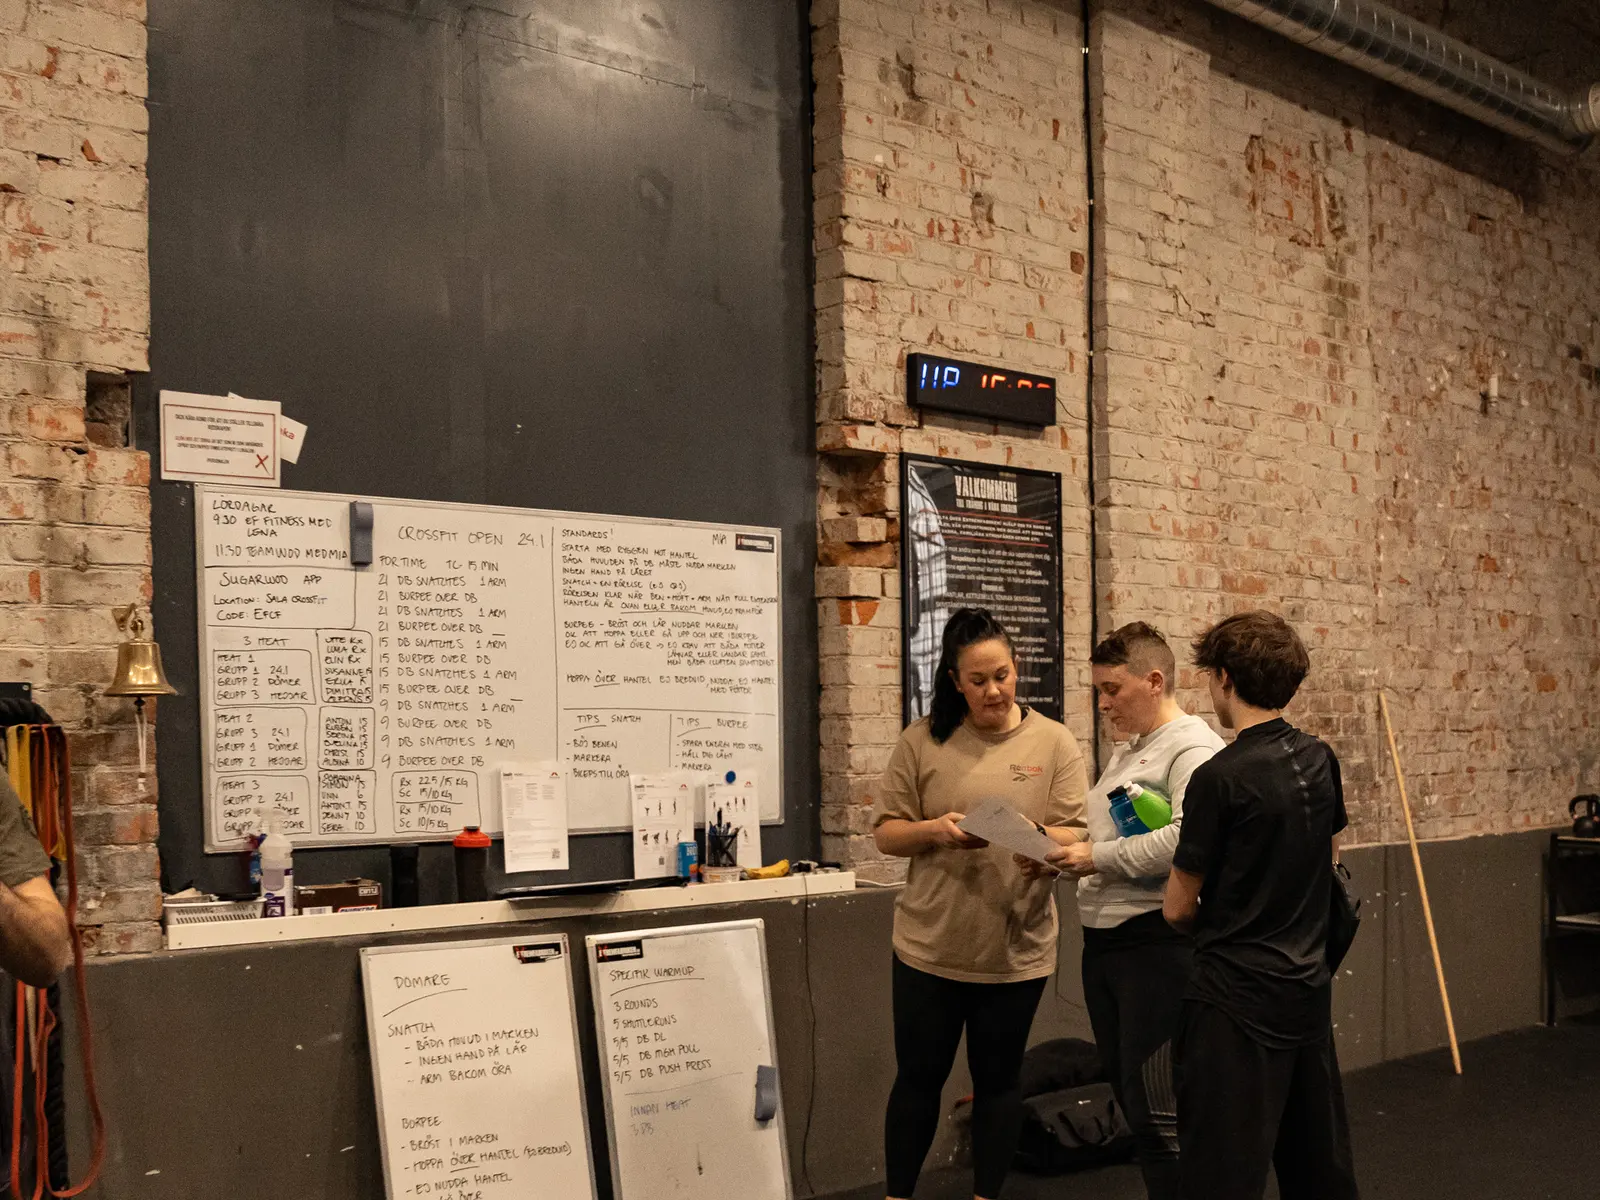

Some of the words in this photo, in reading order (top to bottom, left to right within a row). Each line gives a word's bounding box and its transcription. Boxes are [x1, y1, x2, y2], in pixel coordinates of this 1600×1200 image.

[263, 516, 305, 527] FITNESS
[309, 517, 333, 528] MED
[398, 526, 459, 542] CROSSFIT
[468, 532, 503, 545] OPEN
[517, 533, 545, 548] 24.1
[561, 543, 590, 552] STARTA
[480, 561, 499, 571] MIN
[219, 572, 288, 587] SUGARWOD
[303, 574, 322, 585] APP
[378, 574, 389, 586] 21
[397, 576, 413, 586] DB
[487, 577, 507, 587] ARM
[266, 593, 288, 604] SALA
[377, 591, 389, 602] 21
[398, 591, 432, 602] BURPEE
[435, 592, 459, 602] OVER
[465, 593, 478, 603] DB
[254, 608, 282, 620] EFCF
[377, 605, 389, 616] 21
[396, 605, 411, 616] DB
[488, 608, 507, 619] ARM
[378, 621, 389, 632] 21
[398, 621, 439, 632] BURPEE
[441, 621, 466, 633] OVER
[469, 623, 484, 634] DB
[244, 636, 251, 646] 3
[378, 637, 389, 647] 15
[397, 638, 411, 647] DB
[486, 640, 507, 650] ARM
[379, 653, 390, 664] 15
[398, 653, 436, 664] BURPEE
[441, 654, 468, 664] OVER
[476, 655, 491, 665] DB
[379, 667, 389, 677] 15
[397, 667, 415, 677] DB
[418, 667, 477, 679] SNATCHES
[495, 670, 517, 680] ARM
[217, 677, 248, 687] GRUPP
[379, 684, 390, 694] 15
[397, 684, 440, 694] BURPEE
[444, 684, 470, 695] OVER
[478, 685, 494, 696] DB
[379, 699, 389, 712] 9
[397, 700, 412, 711] DB
[492, 703, 515, 713] ARM
[380, 715, 389, 729] 9
[397, 718, 438, 729] BURPEE
[443, 719, 468, 729] OVER
[476, 719, 492, 730] DB
[381, 734, 390, 748] 9
[398, 737, 413, 747] DB
[495, 738, 515, 749] ARM
[381, 754, 391, 769] 9
[398, 755, 437, 766] BURPEE
[441, 756, 465, 766] OVER
[471, 756, 485, 766] DB
[654, 965, 695, 978] WARMUP
[393, 973, 450, 989] DOMARE
[613, 1001, 622, 1012] 3
[624, 997, 659, 1010] ROUNDS
[613, 1018, 621, 1030] 5
[492, 1027, 539, 1041] MARKEN
[613, 1035, 629, 1049] 5/5
[636, 1033, 651, 1044] DB
[654, 1032, 667, 1042] DL
[455, 1049, 485, 1061] HAND
[613, 1053, 630, 1067] 5/5
[639, 1051, 652, 1061] DB
[678, 1044, 701, 1055] PULL
[420, 1074, 442, 1085] ARM
[448, 1068, 487, 1082] BAKOM
[614, 1070, 632, 1084] 5/5
[640, 1067, 654, 1079] DB
[659, 1062, 681, 1074] PUSH
[686, 1059, 712, 1071] PRESS
[459, 1133, 499, 1146] MARKEN
[413, 1159, 444, 1172] HOPPA
[480, 1149, 520, 1163] HANTEL
[434, 1177, 469, 1191] NUDDA
[474, 1172, 513, 1185] HANTEL
